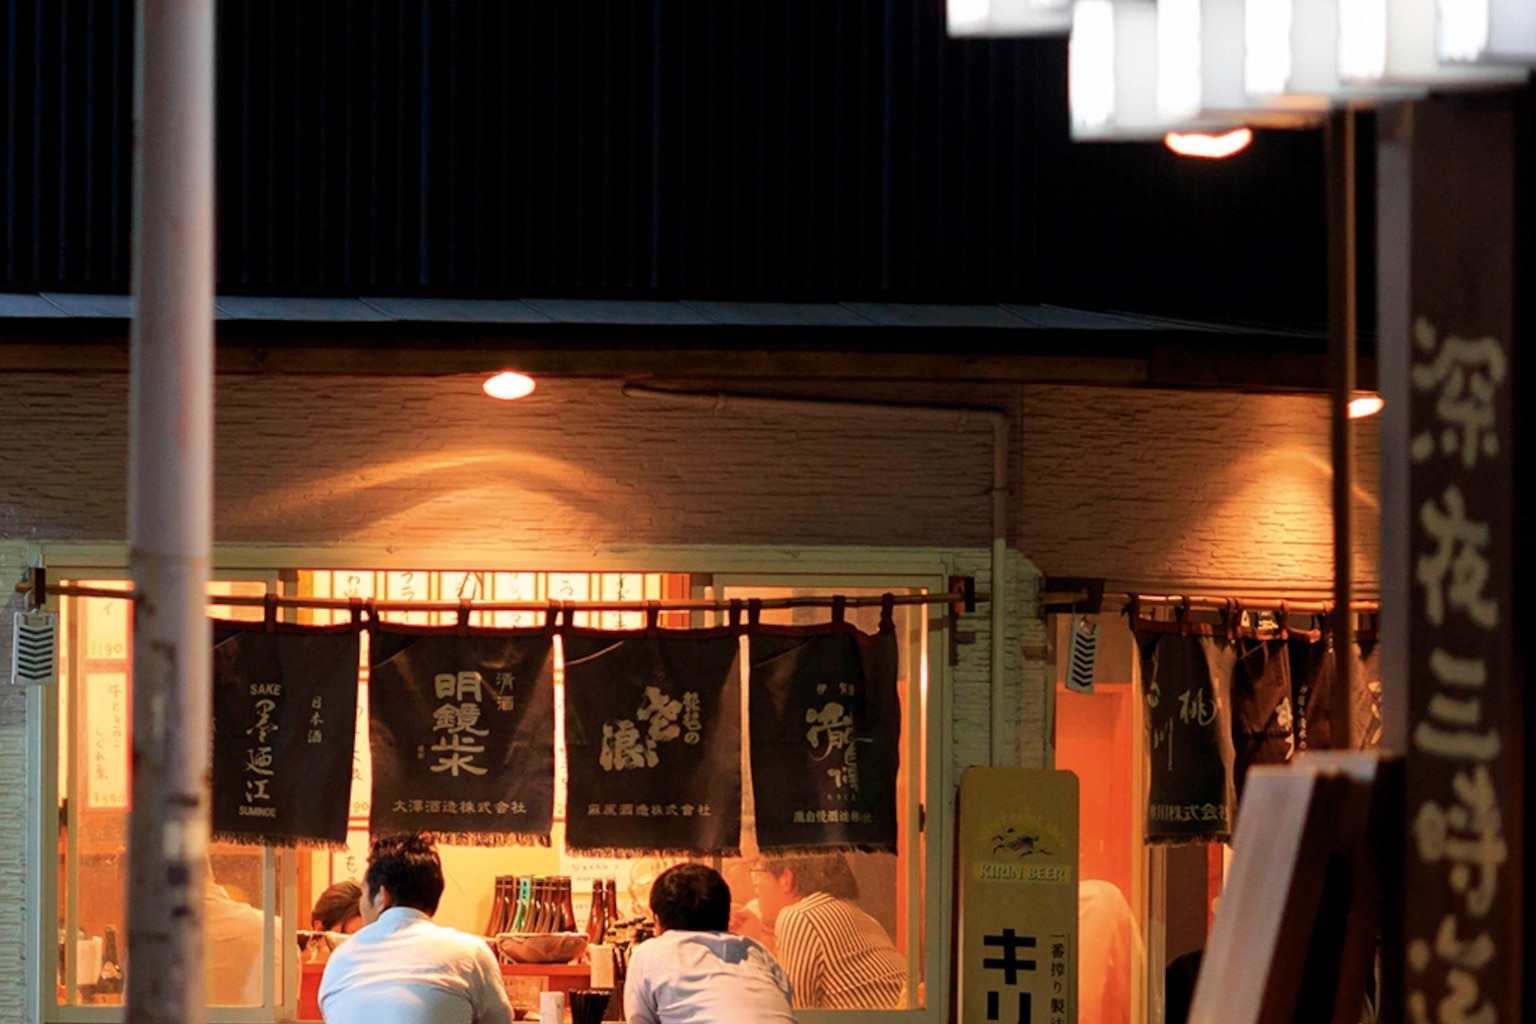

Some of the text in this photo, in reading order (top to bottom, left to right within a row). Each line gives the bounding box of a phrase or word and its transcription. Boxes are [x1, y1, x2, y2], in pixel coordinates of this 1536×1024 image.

[250, 683, 282, 696] SAKE
[496, 672, 514, 711] 清酒
[307, 696, 324, 743] 日本酒
[430, 671, 490, 777] 明鏡止水
[980, 865, 1066, 882] KIRIN BEER
